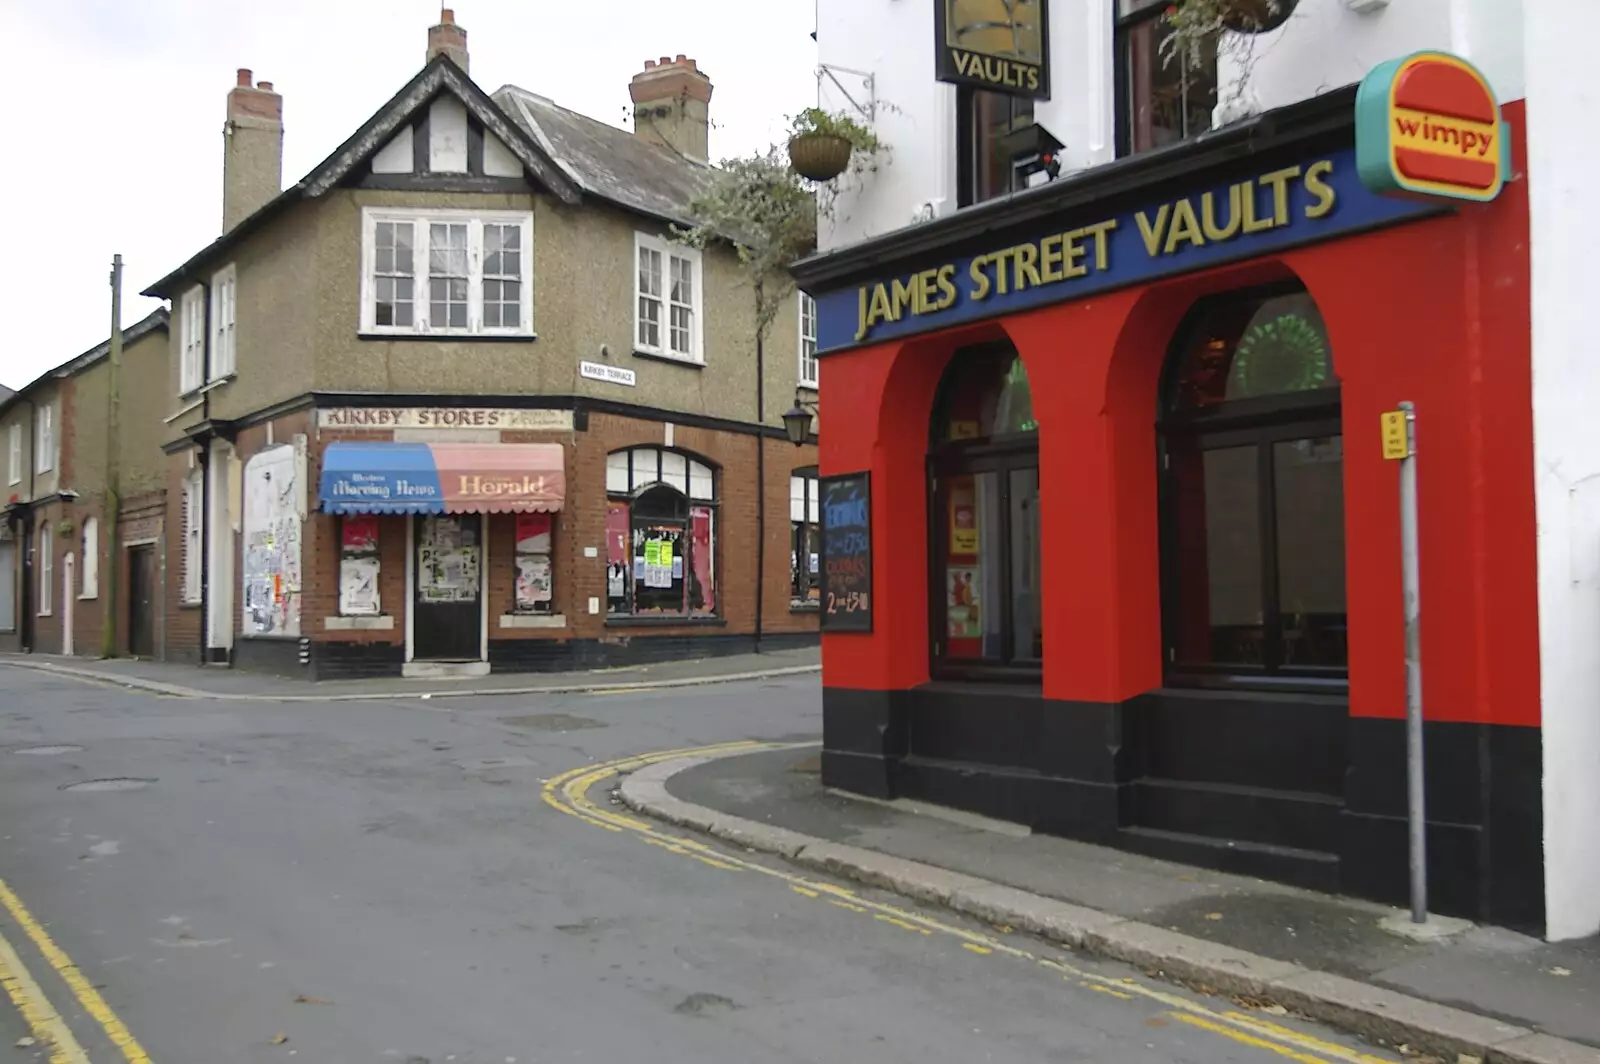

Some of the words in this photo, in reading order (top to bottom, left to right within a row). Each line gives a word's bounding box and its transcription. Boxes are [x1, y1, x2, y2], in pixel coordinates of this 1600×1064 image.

[952, 49, 1038, 90] VAULTS
[1395, 116, 1493, 156] wimpy
[854, 264, 958, 341] JAMES
[969, 218, 1117, 300] STREET
[1134, 160, 1335, 258] VAULTS
[327, 408, 402, 425] KIRKBY
[418, 410, 500, 426] STORES
[396, 480, 436, 496] News
[458, 475, 544, 494] Herald
